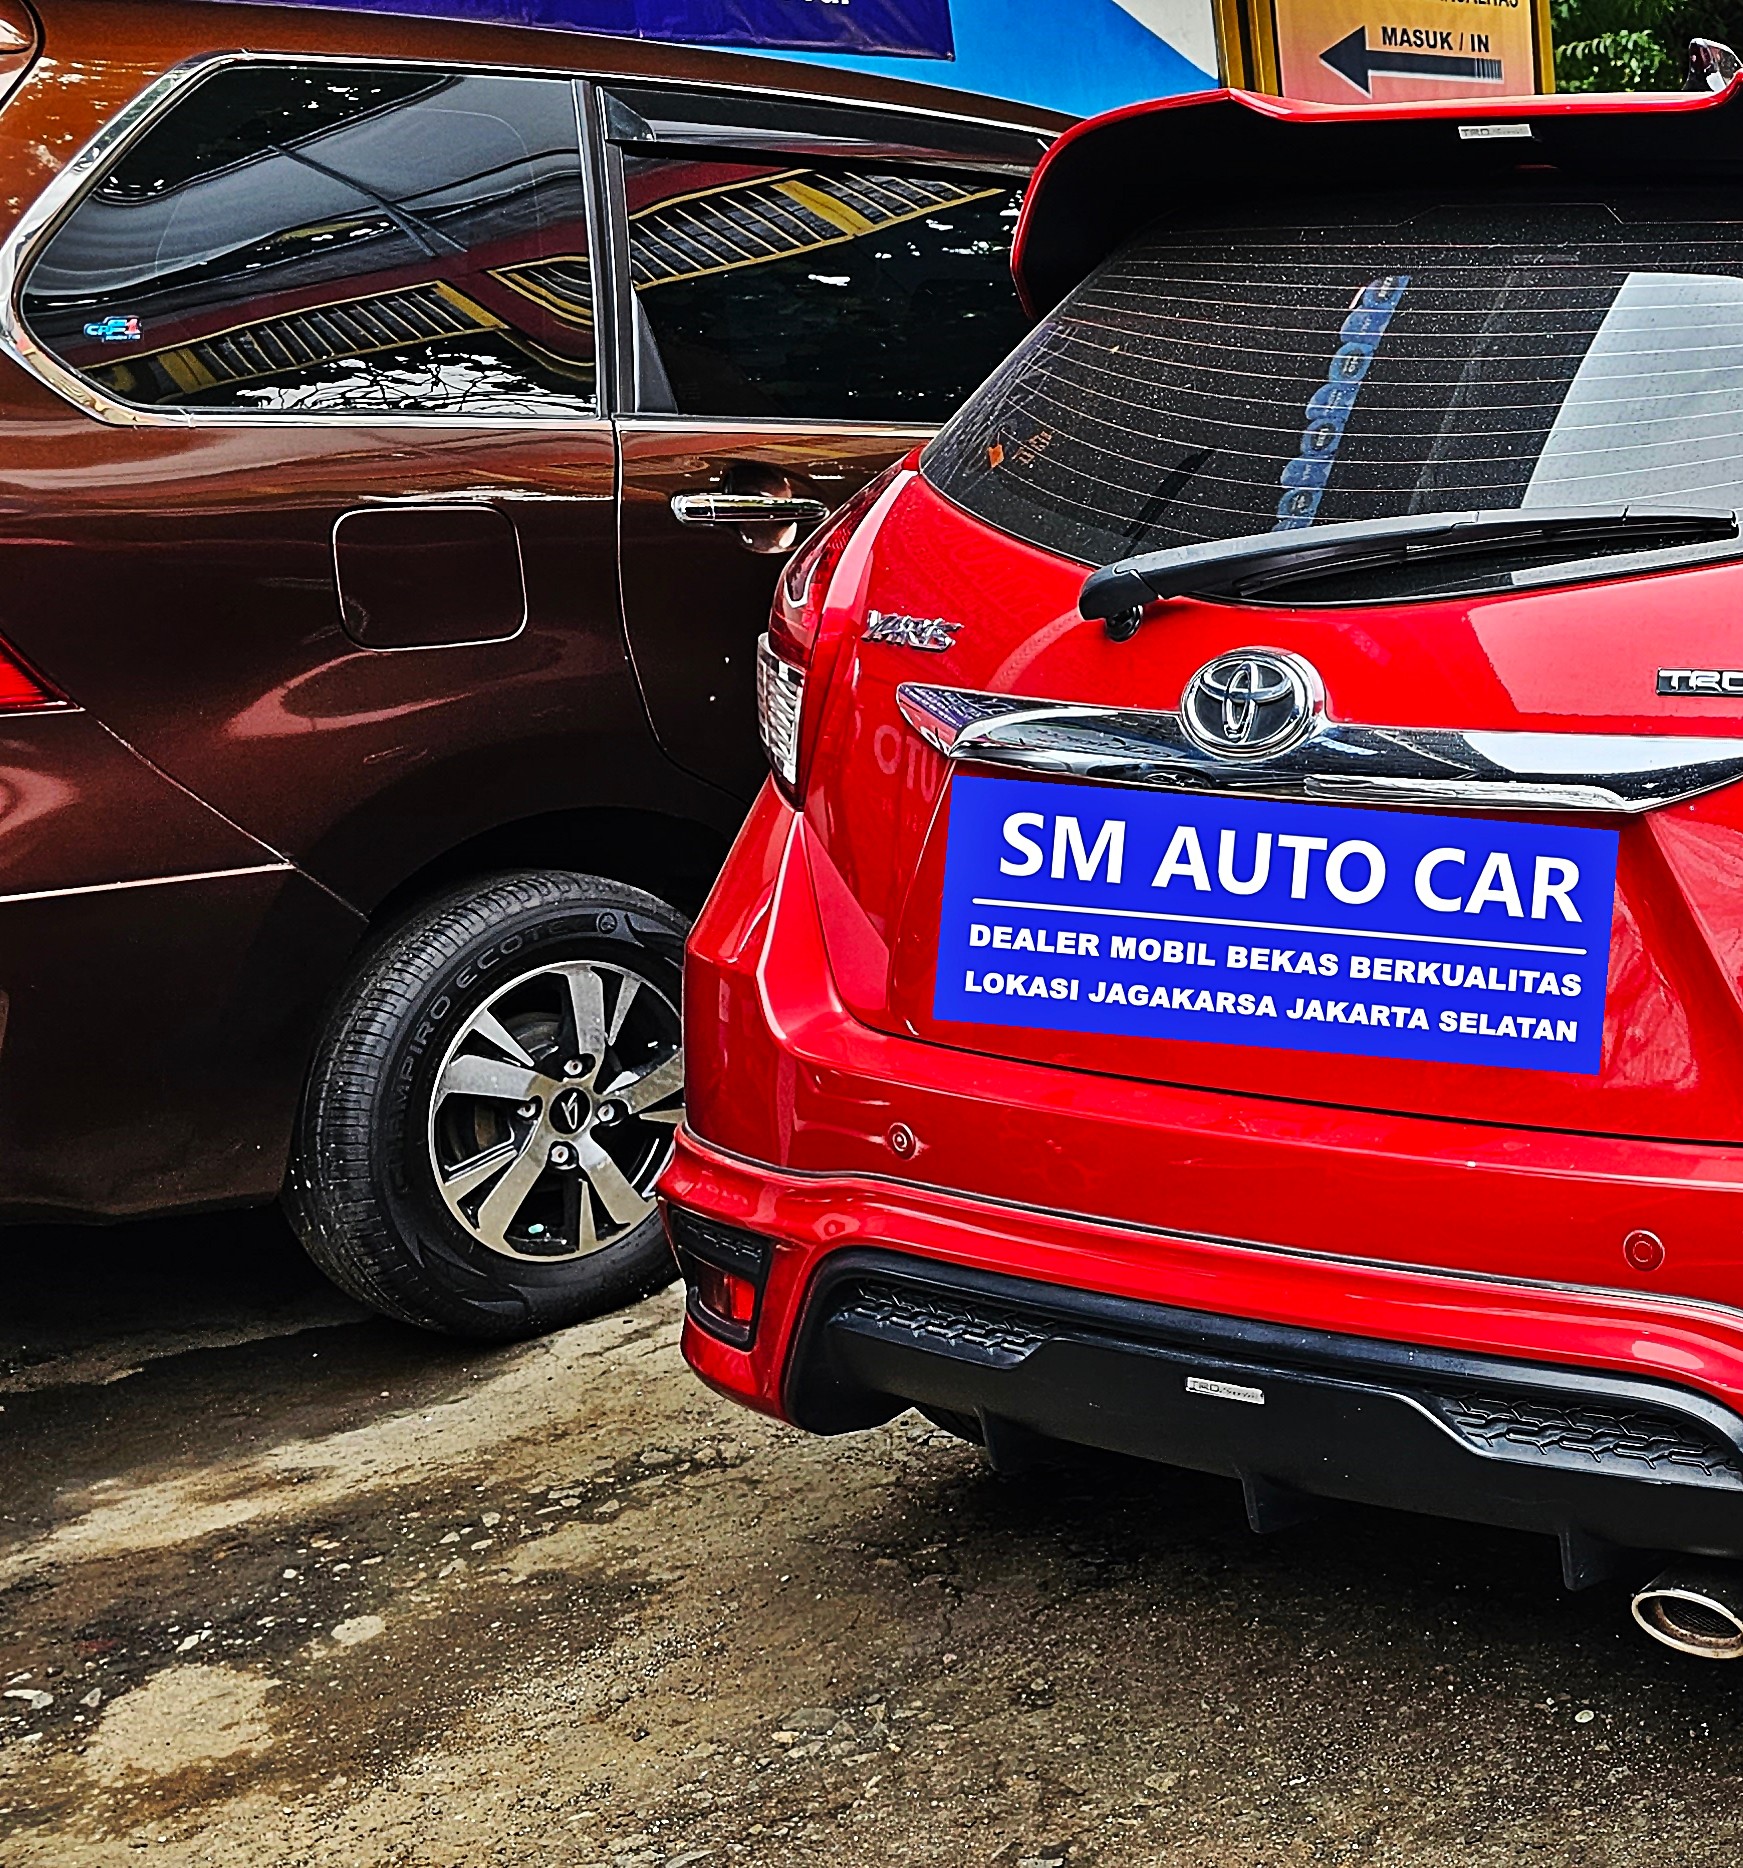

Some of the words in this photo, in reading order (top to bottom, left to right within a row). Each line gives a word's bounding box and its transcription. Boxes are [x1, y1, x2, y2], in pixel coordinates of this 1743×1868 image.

[1381, 25, 1454, 51] MASUK
[1458, 32, 1464, 51] /
[1470, 33, 1490, 53] IN
[455, 918, 584, 989] ECOTE
